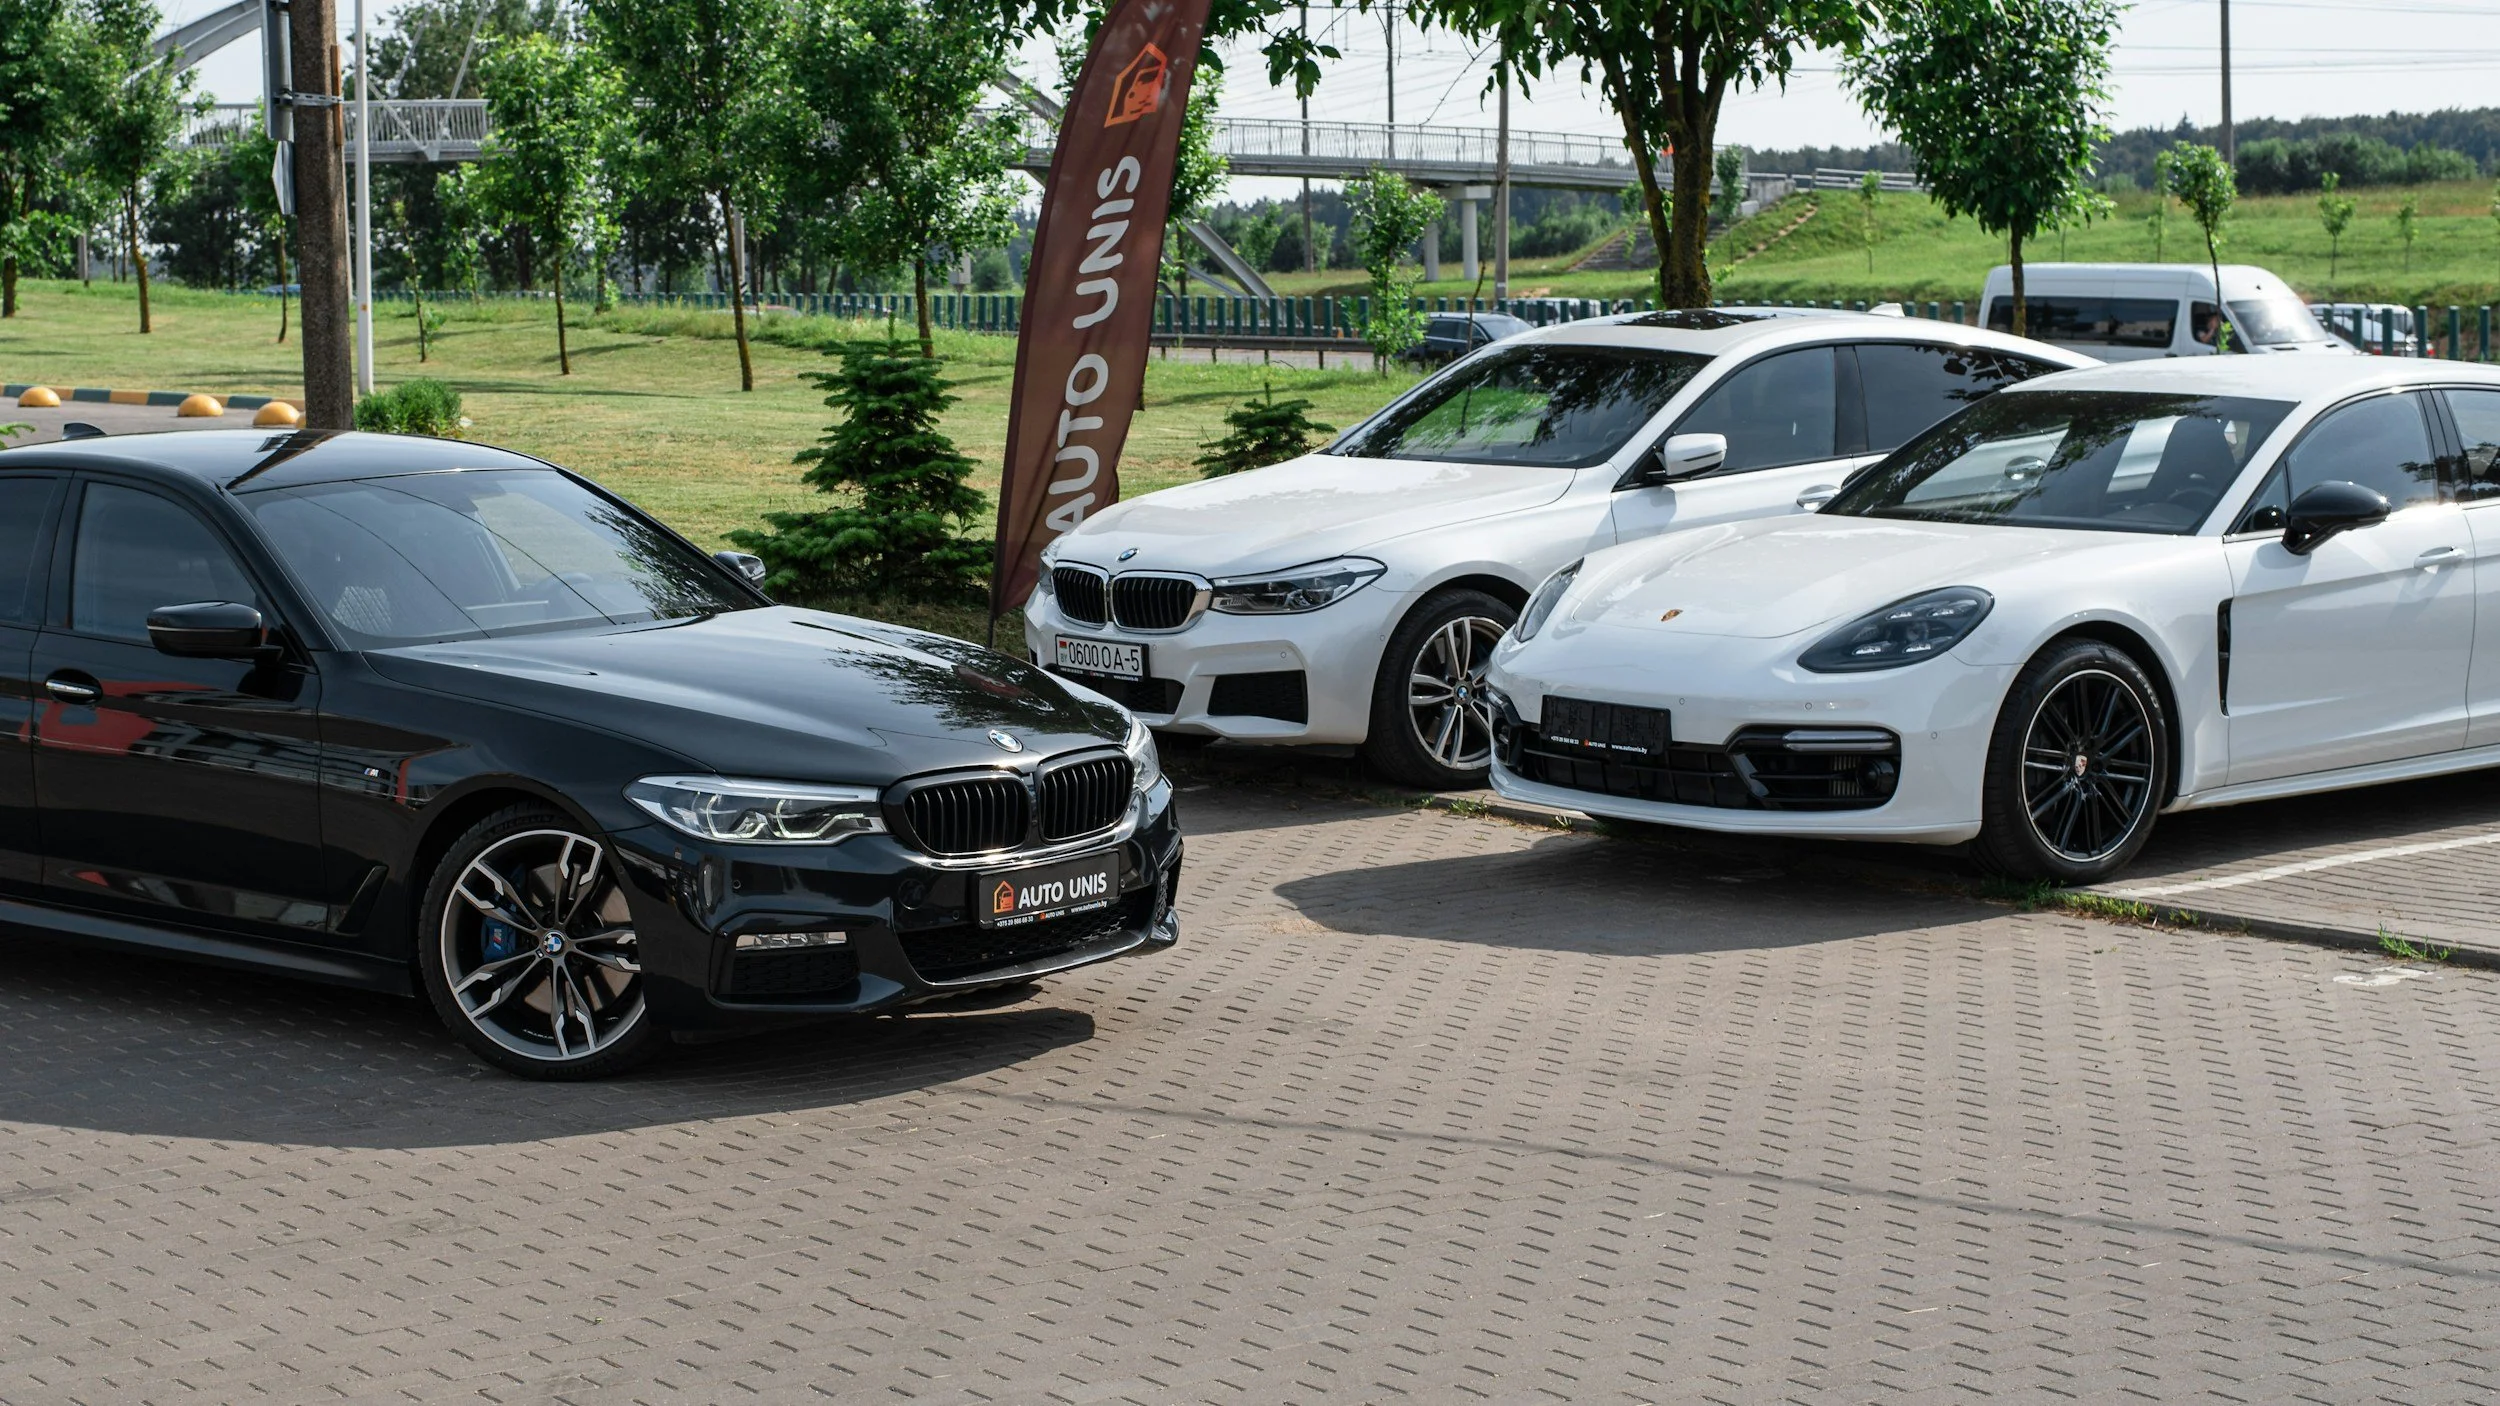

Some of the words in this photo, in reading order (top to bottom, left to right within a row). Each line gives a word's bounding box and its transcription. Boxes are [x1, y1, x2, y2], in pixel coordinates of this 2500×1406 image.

[1073, 156, 1141, 329] UNIS
[1046, 354, 1108, 532] AUTO
[1018, 881, 1064, 909] AUTO
[1069, 872, 1107, 899] UNIS
